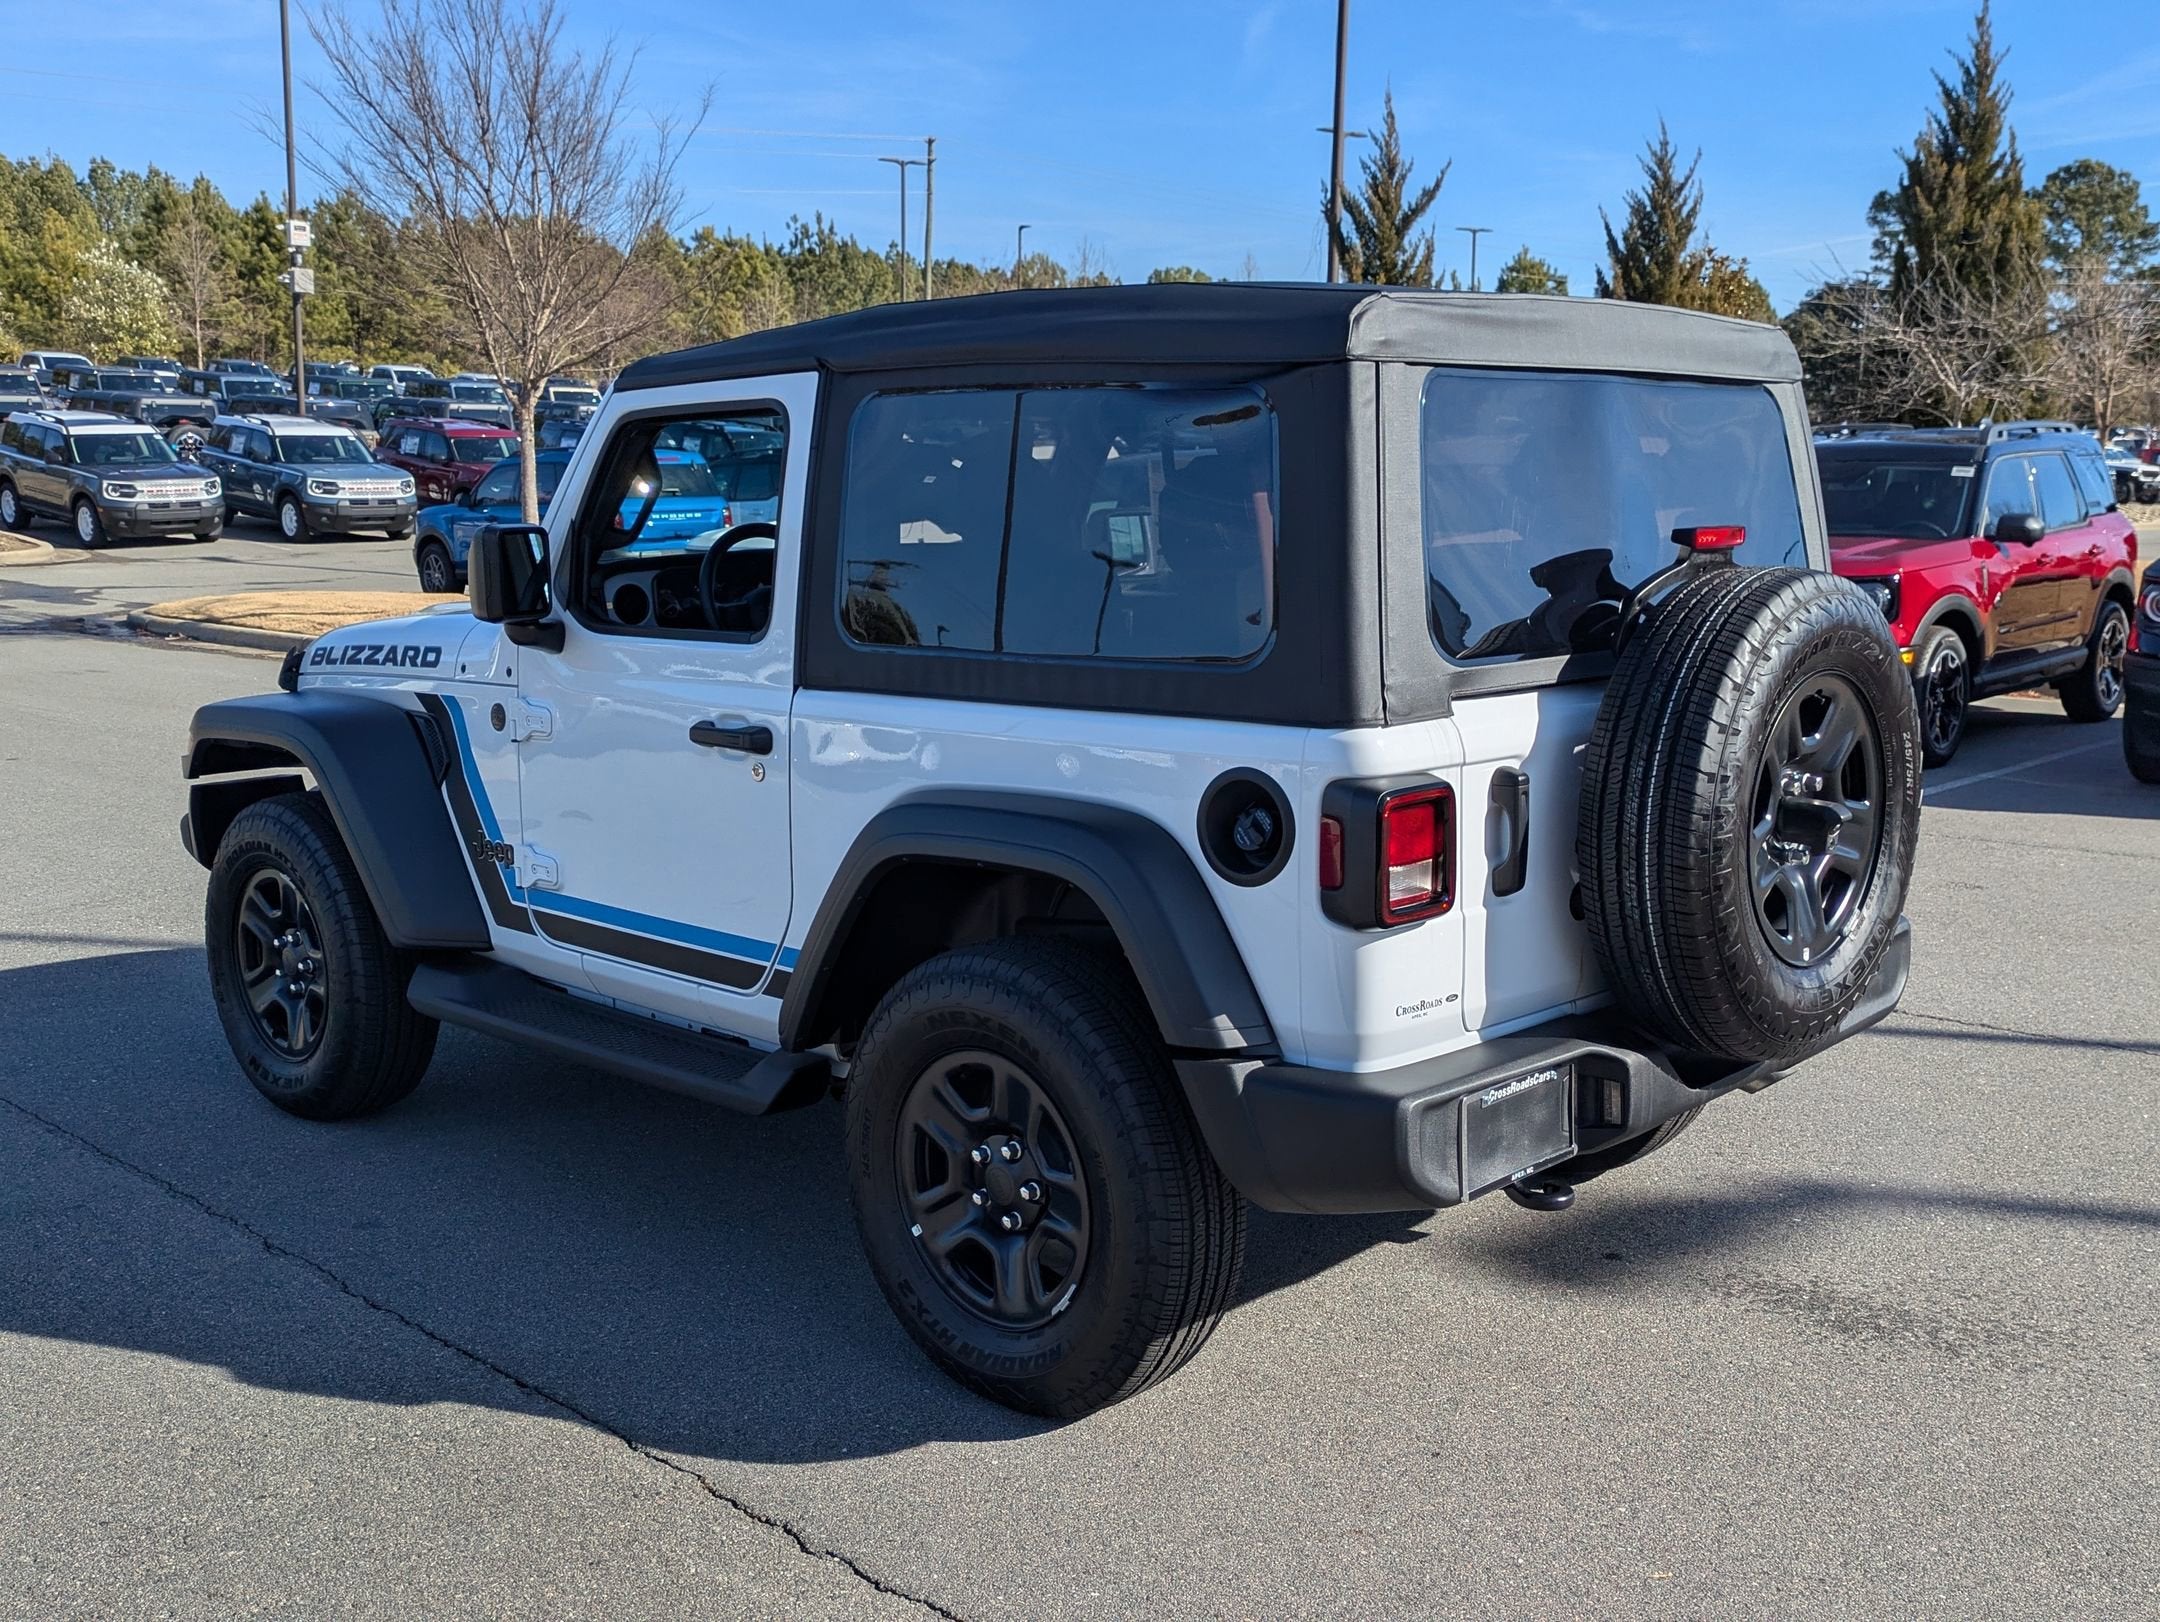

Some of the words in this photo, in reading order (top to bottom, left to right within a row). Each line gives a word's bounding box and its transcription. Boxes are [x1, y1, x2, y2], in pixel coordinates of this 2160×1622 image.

[309, 644, 442, 669] BLIZZARD
[1902, 731, 1916, 804] 245/75R17
[472, 829, 514, 869] Jeep
[1488, 1070, 1551, 1102] CrossRoadsCars
